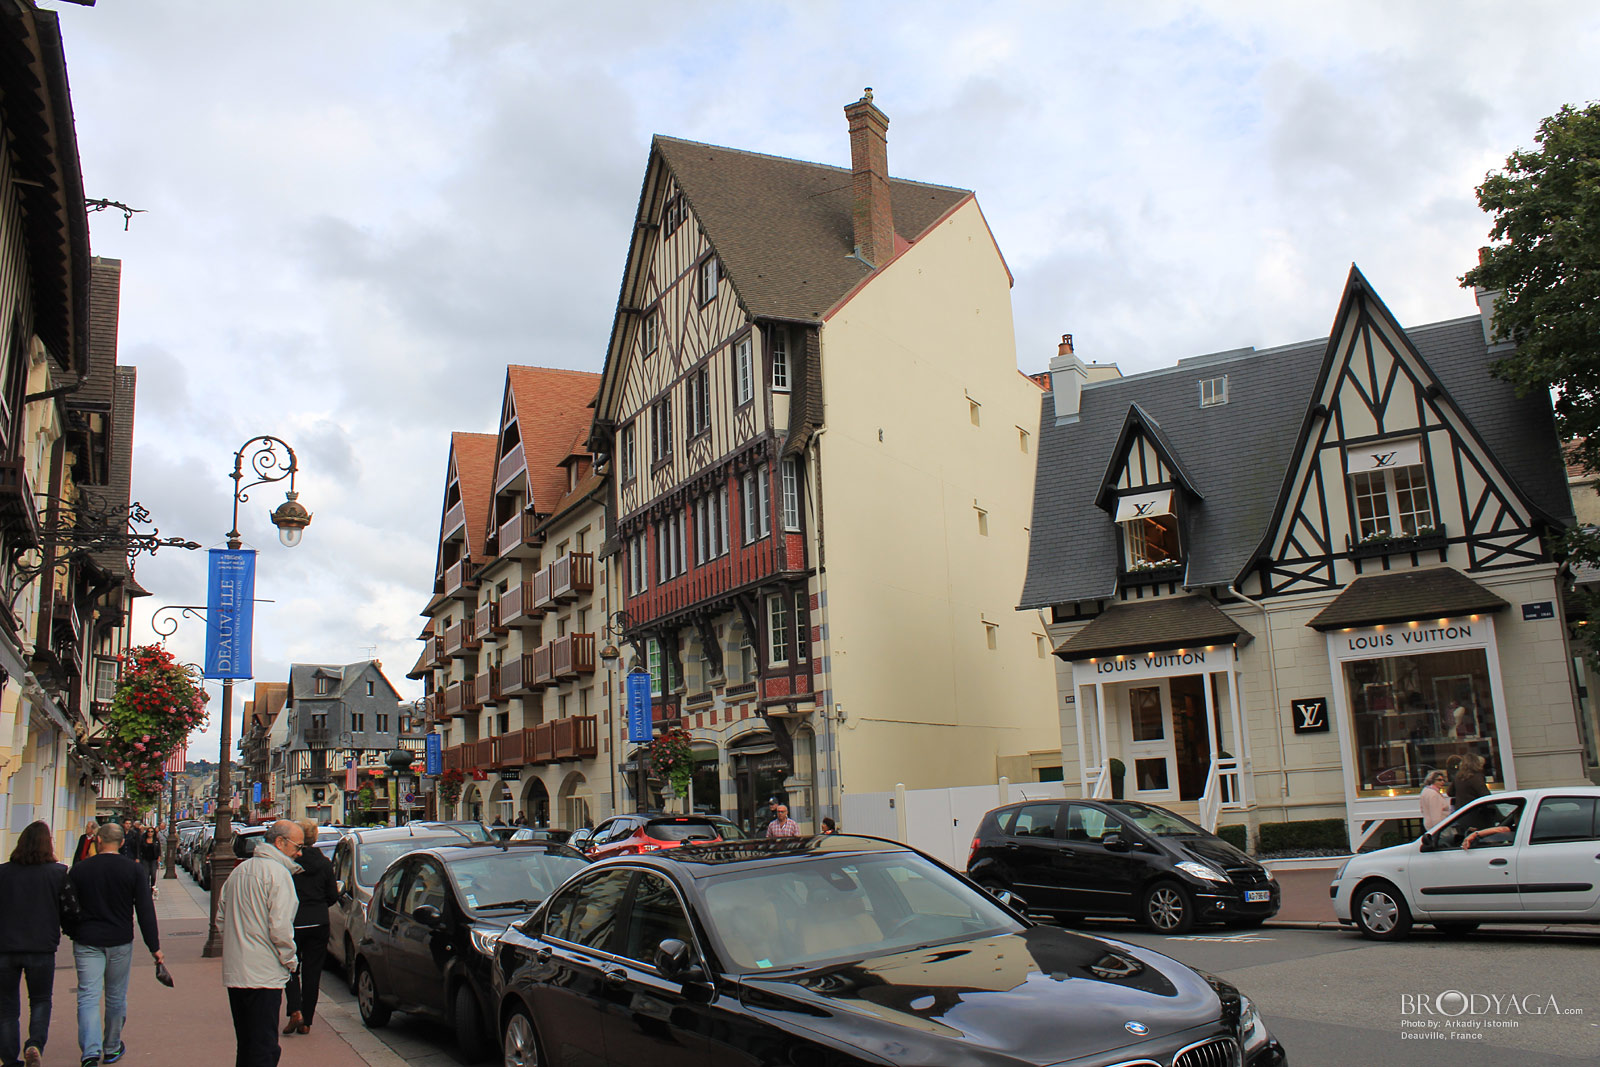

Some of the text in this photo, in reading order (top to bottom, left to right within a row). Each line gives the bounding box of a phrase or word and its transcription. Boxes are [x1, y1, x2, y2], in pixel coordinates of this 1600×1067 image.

[1370, 451, 1397, 468] LV
[1131, 501, 1157, 517] LV
[216, 579, 234, 672] DEAUVILLE
[1349, 625, 1472, 651] LOUIS VUITTON
[1097, 652, 1205, 674] LOUIS VUITTON
[1296, 703, 1323, 728] LV
